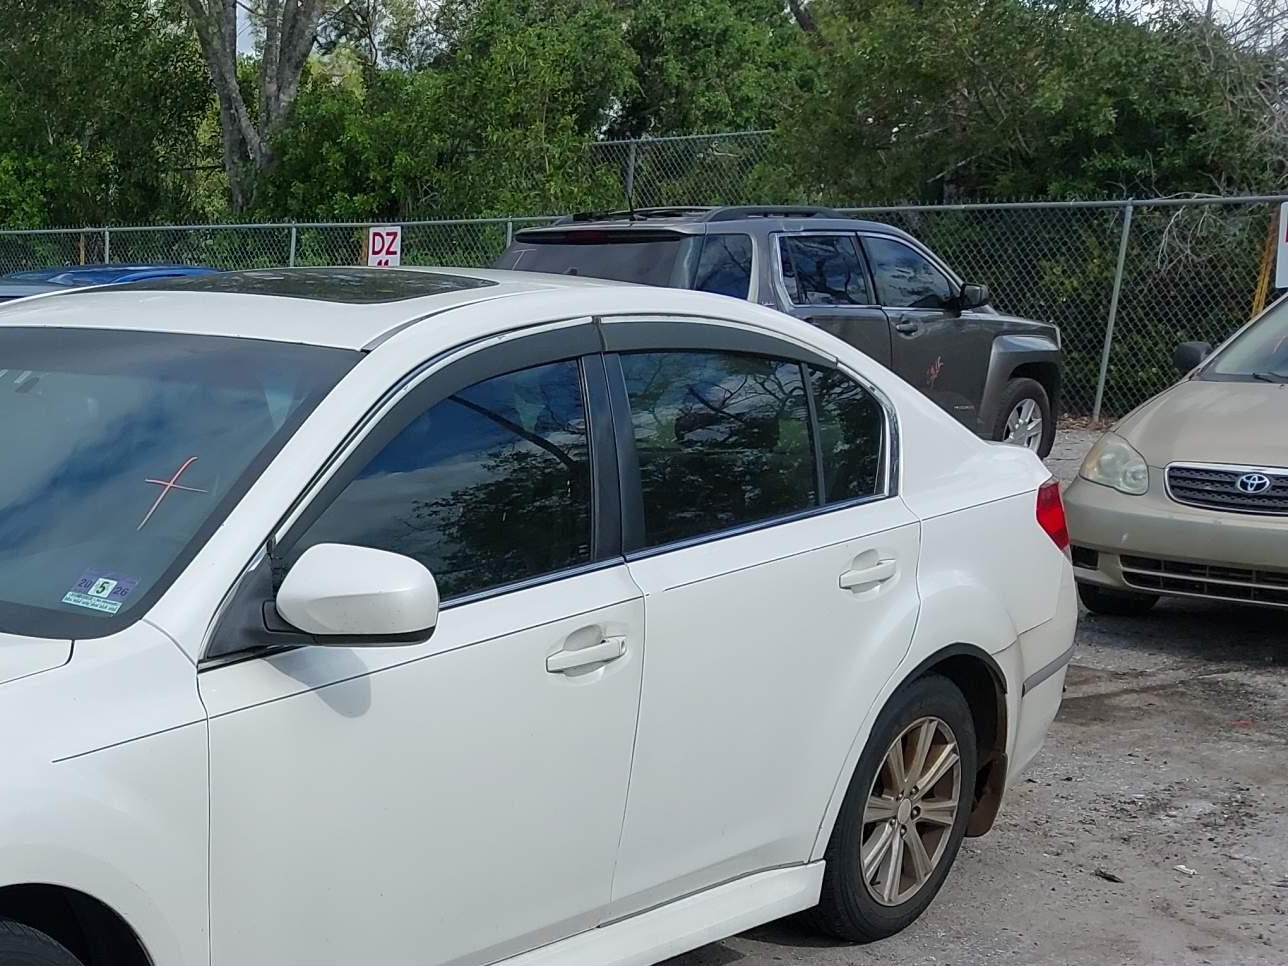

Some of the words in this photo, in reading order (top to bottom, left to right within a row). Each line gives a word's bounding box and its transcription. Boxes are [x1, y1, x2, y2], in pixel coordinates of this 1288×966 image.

[371, 231, 398, 256] DZ
[95, 581, 110, 594] 5
[113, 586, 129, 597] 26
